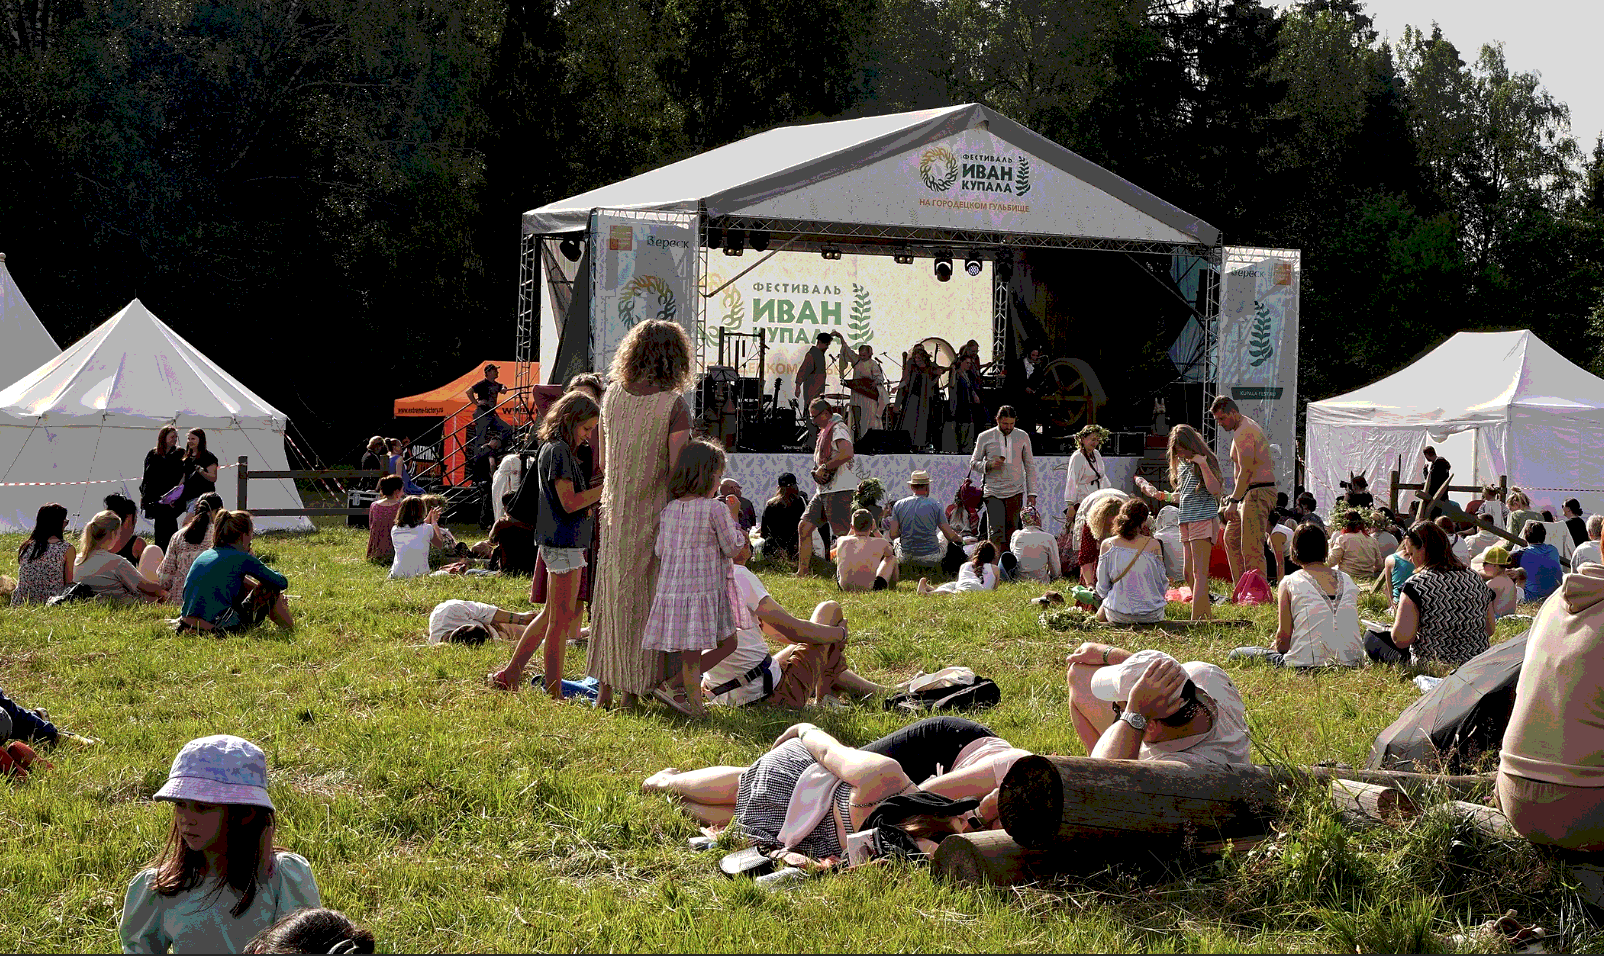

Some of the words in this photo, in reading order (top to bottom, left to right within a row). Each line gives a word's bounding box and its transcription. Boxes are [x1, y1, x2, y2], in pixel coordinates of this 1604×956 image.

[963, 154, 1013, 163] ФЕСТИВАЛЬ
[962, 163, 1013, 181] ИВАН
[961, 180, 1012, 193] КУПАЛА
[919, 198, 931, 207] НА
[932, 199, 988, 210] ГОРОДЕЦКОМ
[989, 202, 1030, 213] ГУЛЬБИЩЕ
[752, 282, 842, 296] ФЕСТИВАЛЬ
[752, 298, 842, 326] ИВАН
